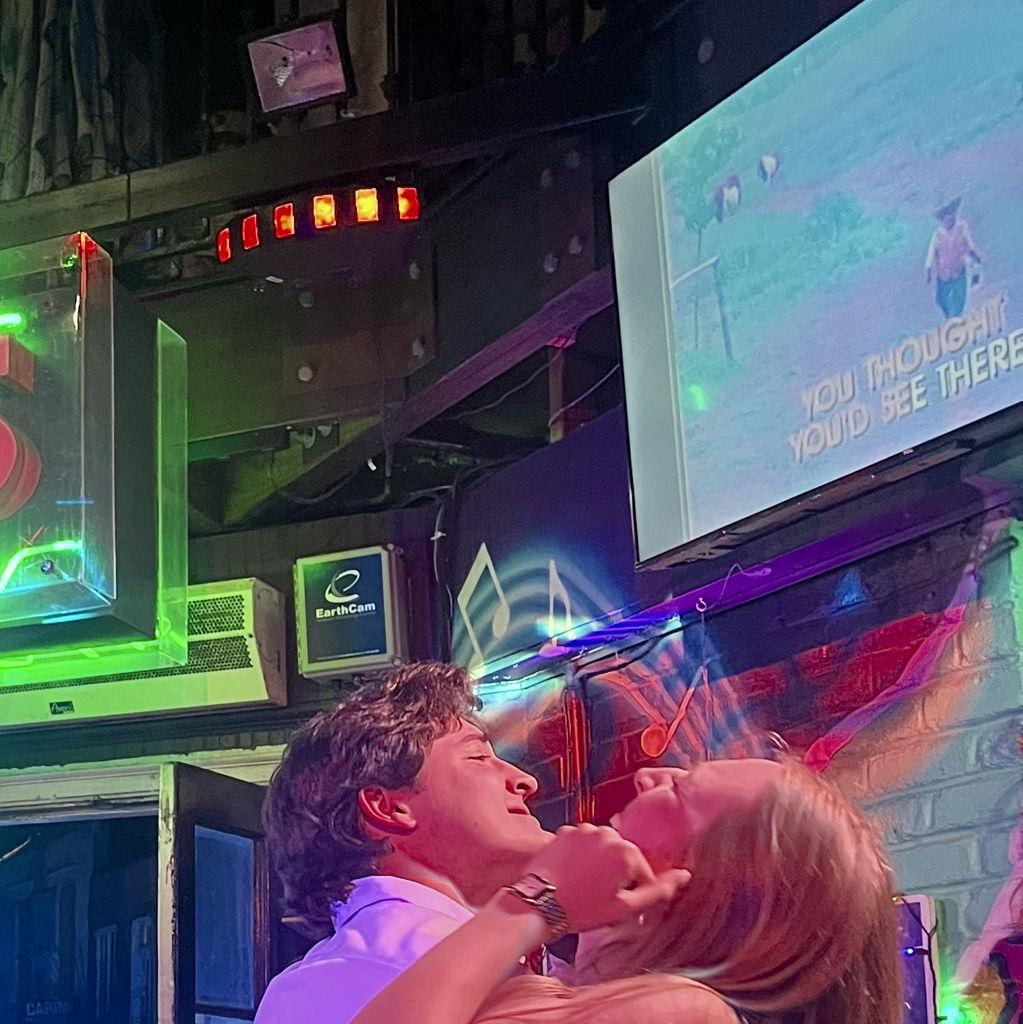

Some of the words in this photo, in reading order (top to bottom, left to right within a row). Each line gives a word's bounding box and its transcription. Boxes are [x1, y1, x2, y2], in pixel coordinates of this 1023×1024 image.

[788, 403, 871, 463] YOU'D
[880, 374, 928, 424] SEE
[936, 328, 1023, 399] THERE
[801, 369, 856, 420] YOU
[864, 295, 1006, 391] THOUGHT
[316, 602, 376, 619] EarthCam
